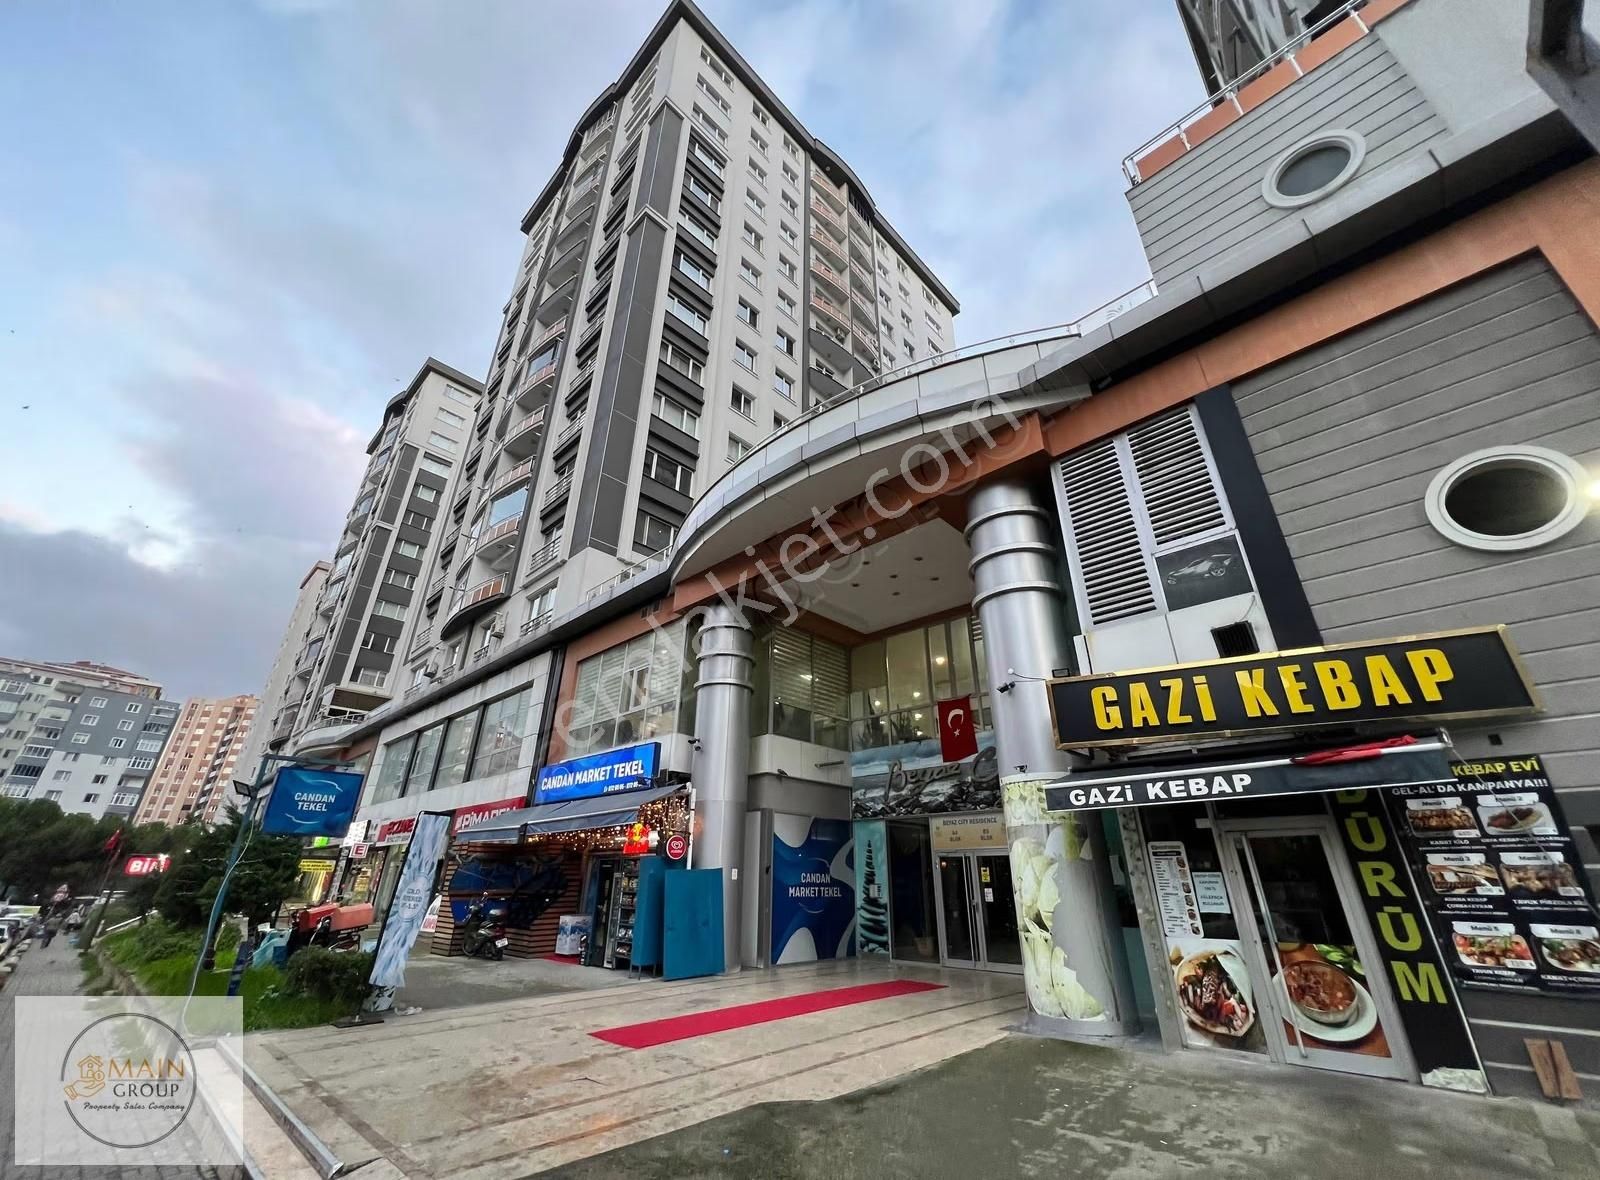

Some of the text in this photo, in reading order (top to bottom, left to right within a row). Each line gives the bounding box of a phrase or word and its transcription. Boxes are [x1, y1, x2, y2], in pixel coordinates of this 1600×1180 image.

[1235, 648, 1456, 717] KEBAP
[1451, 757, 1540, 776] KEBAP EVİ
[542, 760, 644, 790] CANDAN MARKET TEKEL
[885, 760, 960, 803] Beyaz
[1146, 774, 1253, 802] KEBAP
[1457, 778, 1548, 792] KAMPANYA!!!
[294, 792, 336, 803] CANDAN
[297, 802, 328, 812] TEKEL
[354, 844, 365, 855] E
[801, 873, 831, 883] CANDAN
[789, 887, 842, 897] MARKET TEKEL
